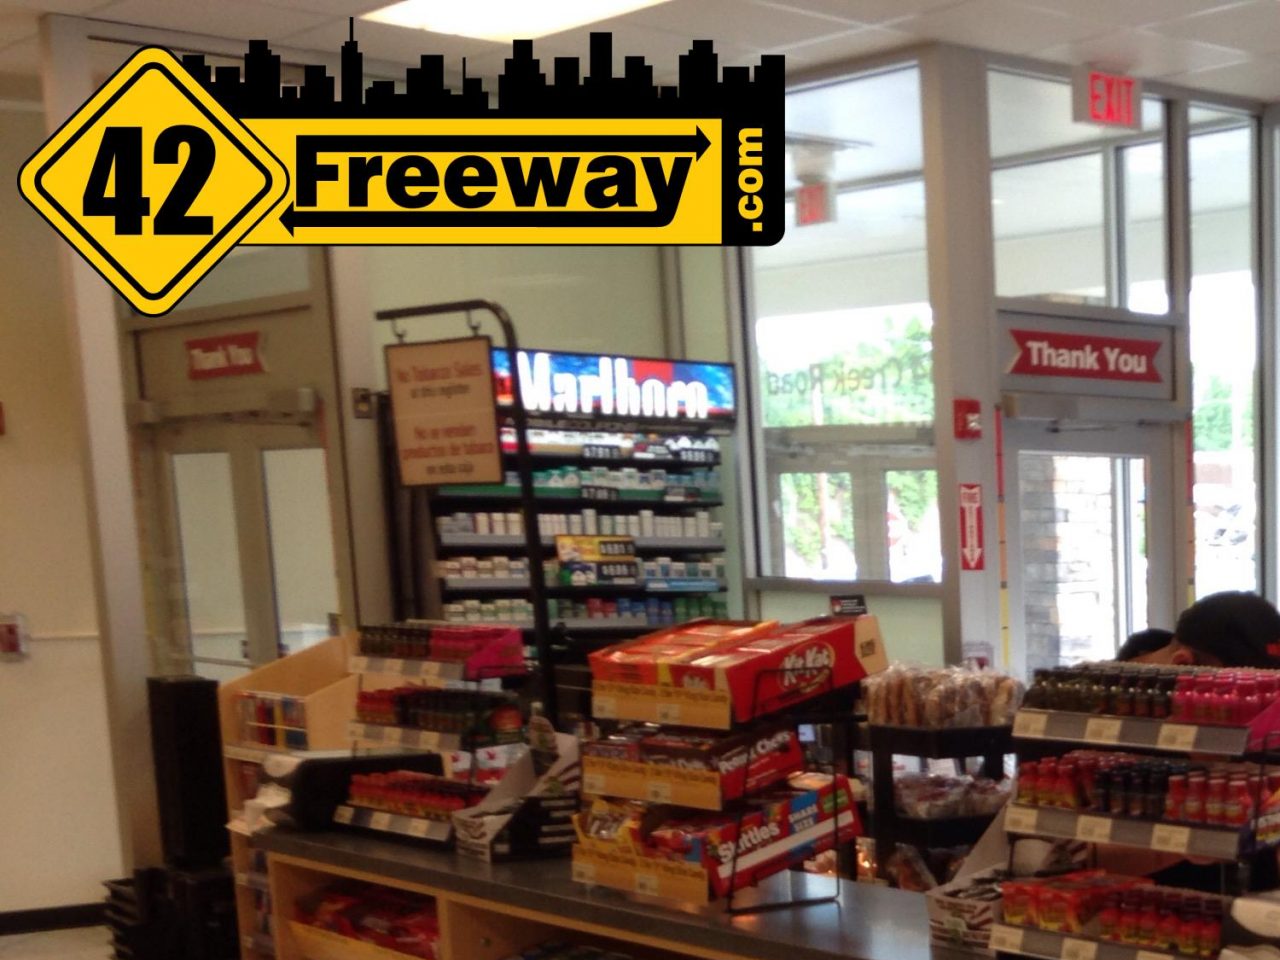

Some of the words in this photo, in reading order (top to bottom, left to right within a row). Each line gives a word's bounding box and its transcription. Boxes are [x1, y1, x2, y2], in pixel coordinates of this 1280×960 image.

[1088, 73, 1134, 126] EXIT
[1026, 340, 1100, 370] Thank
[1103, 346, 1148, 373] You
[514, 350, 709, 419] Marlboro
